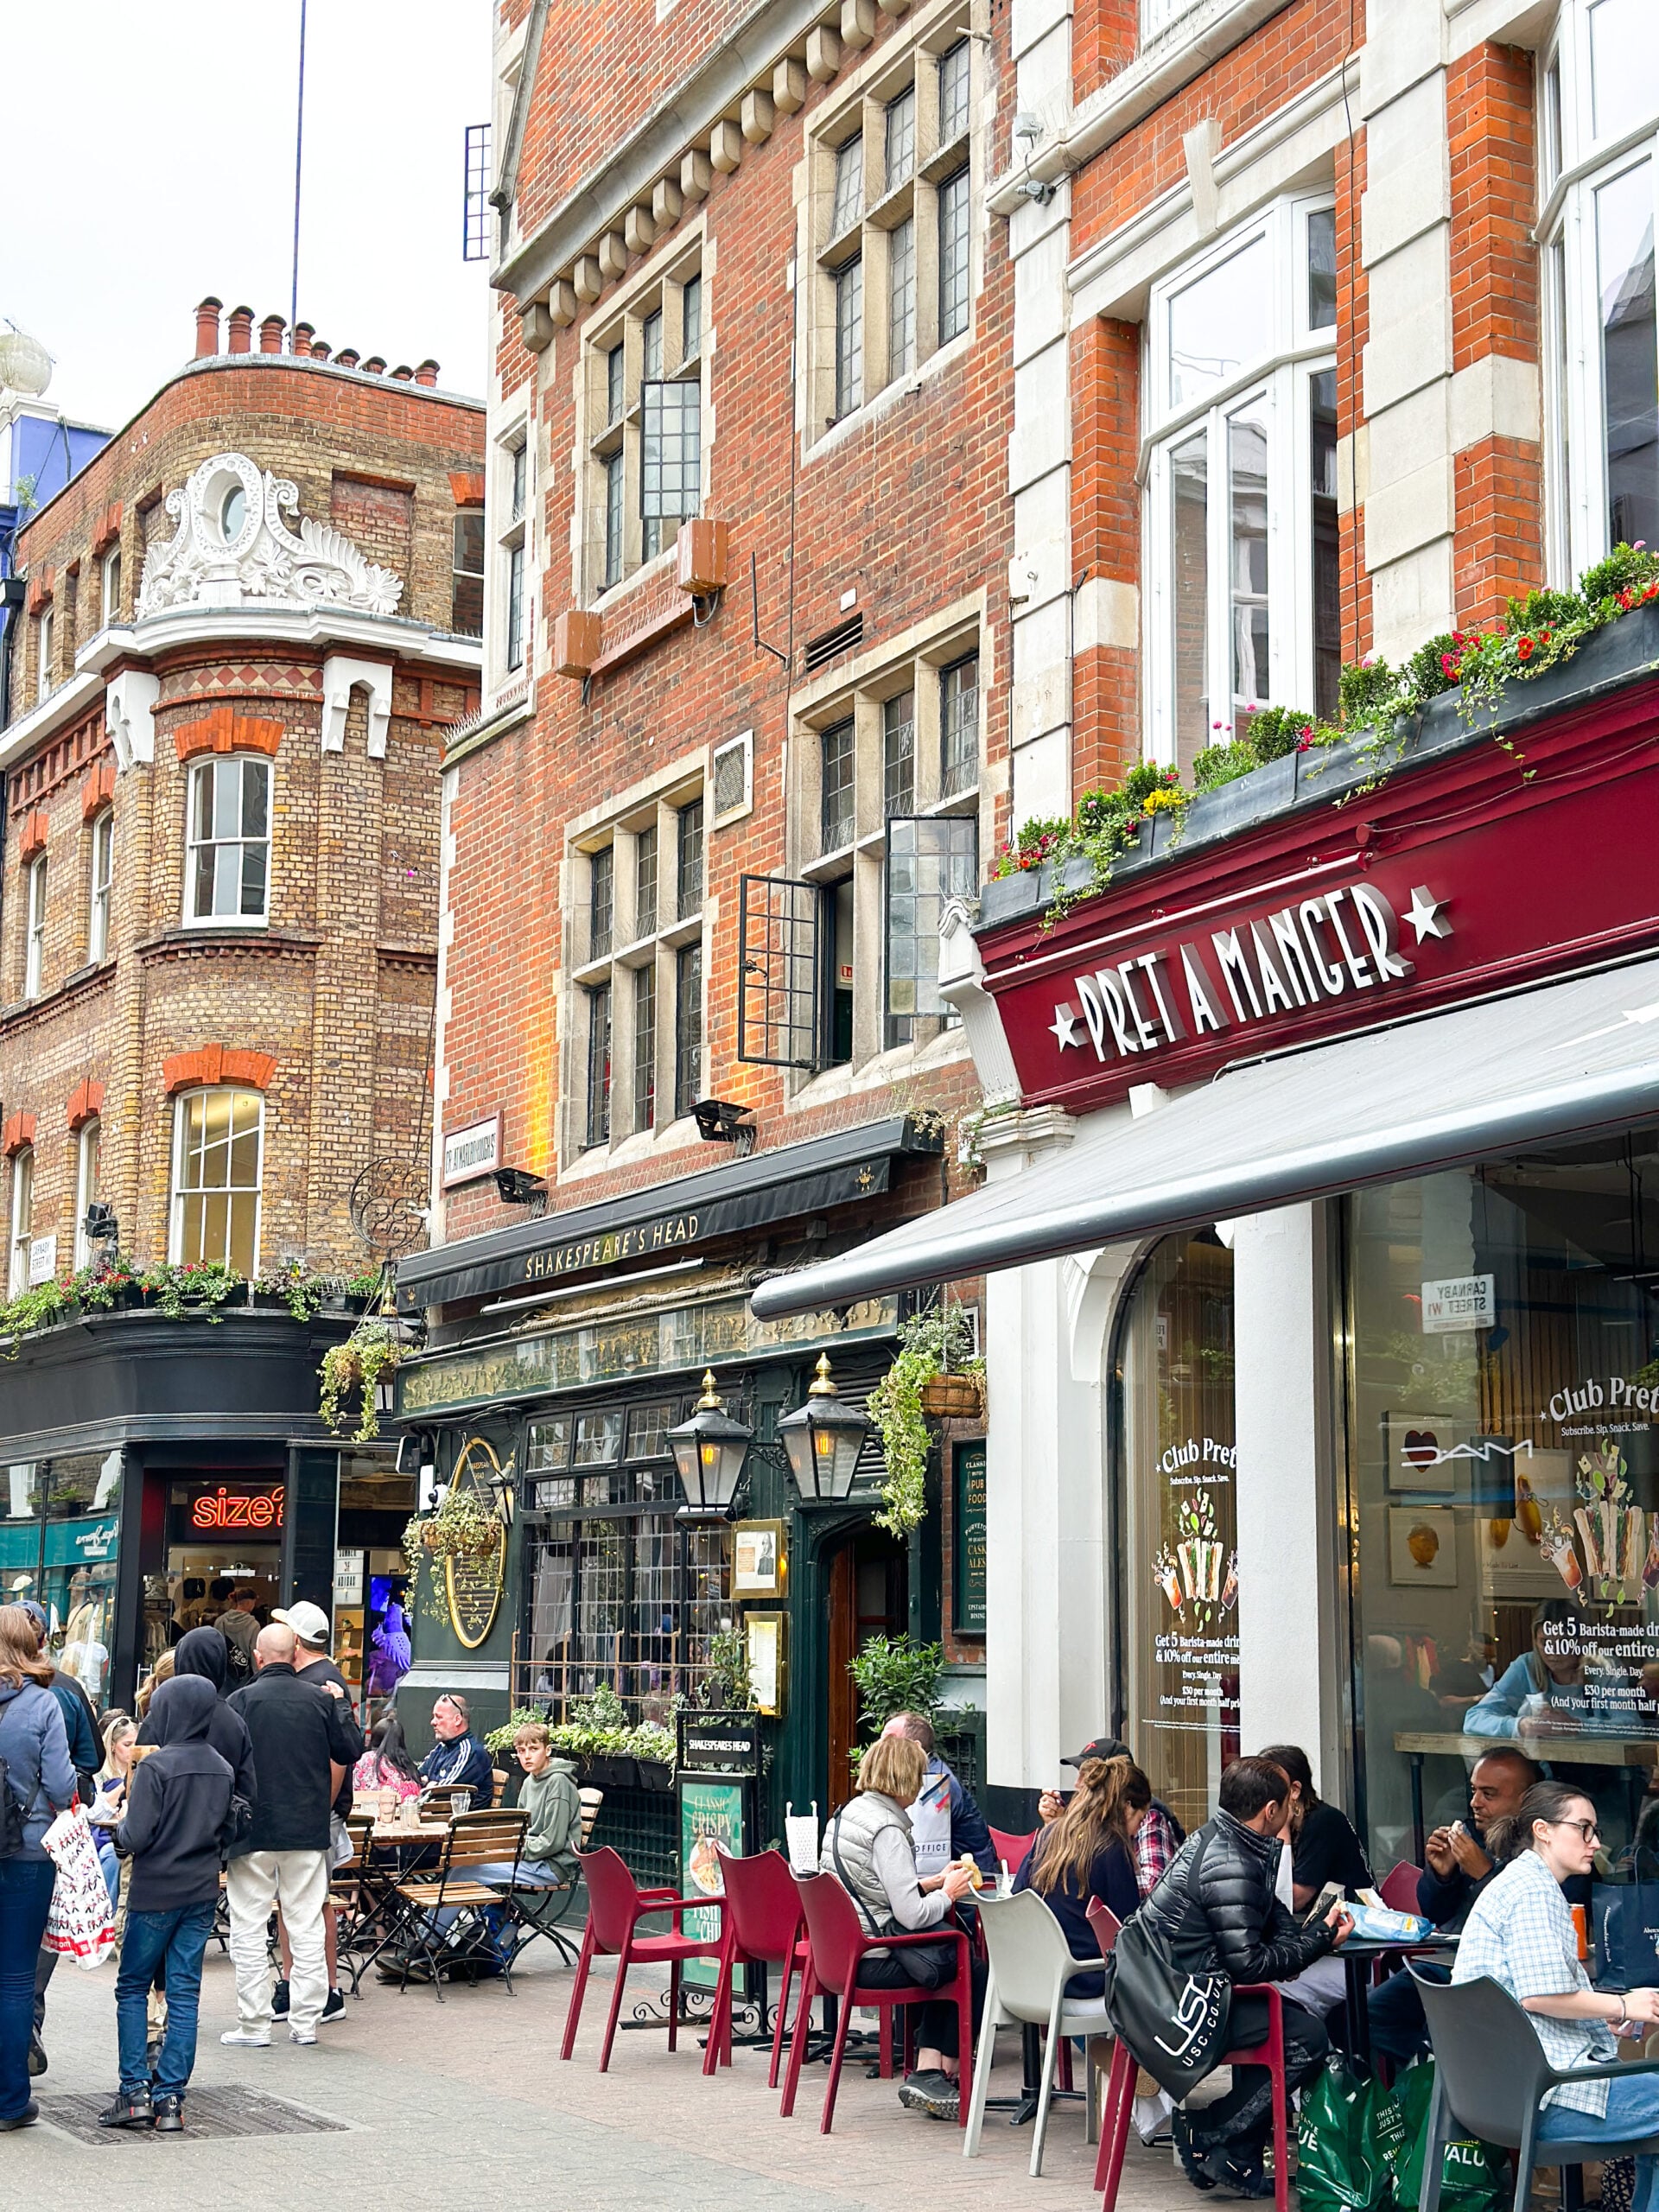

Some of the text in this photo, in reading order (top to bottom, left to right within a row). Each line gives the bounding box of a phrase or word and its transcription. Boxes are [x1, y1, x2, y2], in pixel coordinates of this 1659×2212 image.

[1074, 883, 1408, 1062] PRET A MANGER
[525, 1215, 698, 1279] SHAKESPEARE'S HEAD
[1550, 1377, 1659, 1421] Club Pret
[1561, 1422, 1649, 1436] Subscribe. Sip. Snack. Save.
[1162, 1438, 1236, 1473] Club Pret
[965, 1460, 986, 1469] CLASSI
[971, 1479, 984, 1489] PUB
[968, 1494, 987, 1503] FOOD
[964, 1522, 987, 1536] PURVEYO
[968, 1545, 987, 1554] CASK
[969, 1558, 986, 1568] ALES
[1543, 1620, 1564, 1636] Get
[1567, 1618, 1577, 1636] 5
[1580, 1623, 1644, 1637] Barista-made
[1155, 1631, 1240, 1648] Get 5 Barista-made dri
[1582, 1642, 1598, 1656] off
[1599, 1648, 1614, 1656] our
[1615, 1640, 1656, 1657] entire
[1181, 1651, 1192, 1663] off
[1204, 1650, 1230, 1664] entire
[1585, 1666, 1643, 1678] Every. Single. Day.
[1182, 1686, 1192, 1694] £30
[1205, 1687, 1224, 1696] month
[1585, 1684, 1646, 1698] £30 per month
[1160, 1694, 1241, 1710] (And your first month half pri
[1551, 1695, 1569, 1707] (And
[1571, 1699, 1590, 1710] your
[1591, 1698, 1608, 1709] first
[1610, 1699, 1637, 1711] month
[1637, 1700, 1656, 1712] half
[733, 1740, 751, 1752] HEAD
[695, 1796, 728, 1812] CLASSIC
[692, 1811, 731, 1836] CRISPY
[914, 1843, 946, 1853] OFFICE
[700, 1921, 721, 1943] CHI
[1376, 2107, 1393, 2121] THIS
[1378, 2114, 1396, 2130] JUST
[1389, 2128, 1406, 2143] THIS
[1444, 2144, 1485, 2167] ALU
